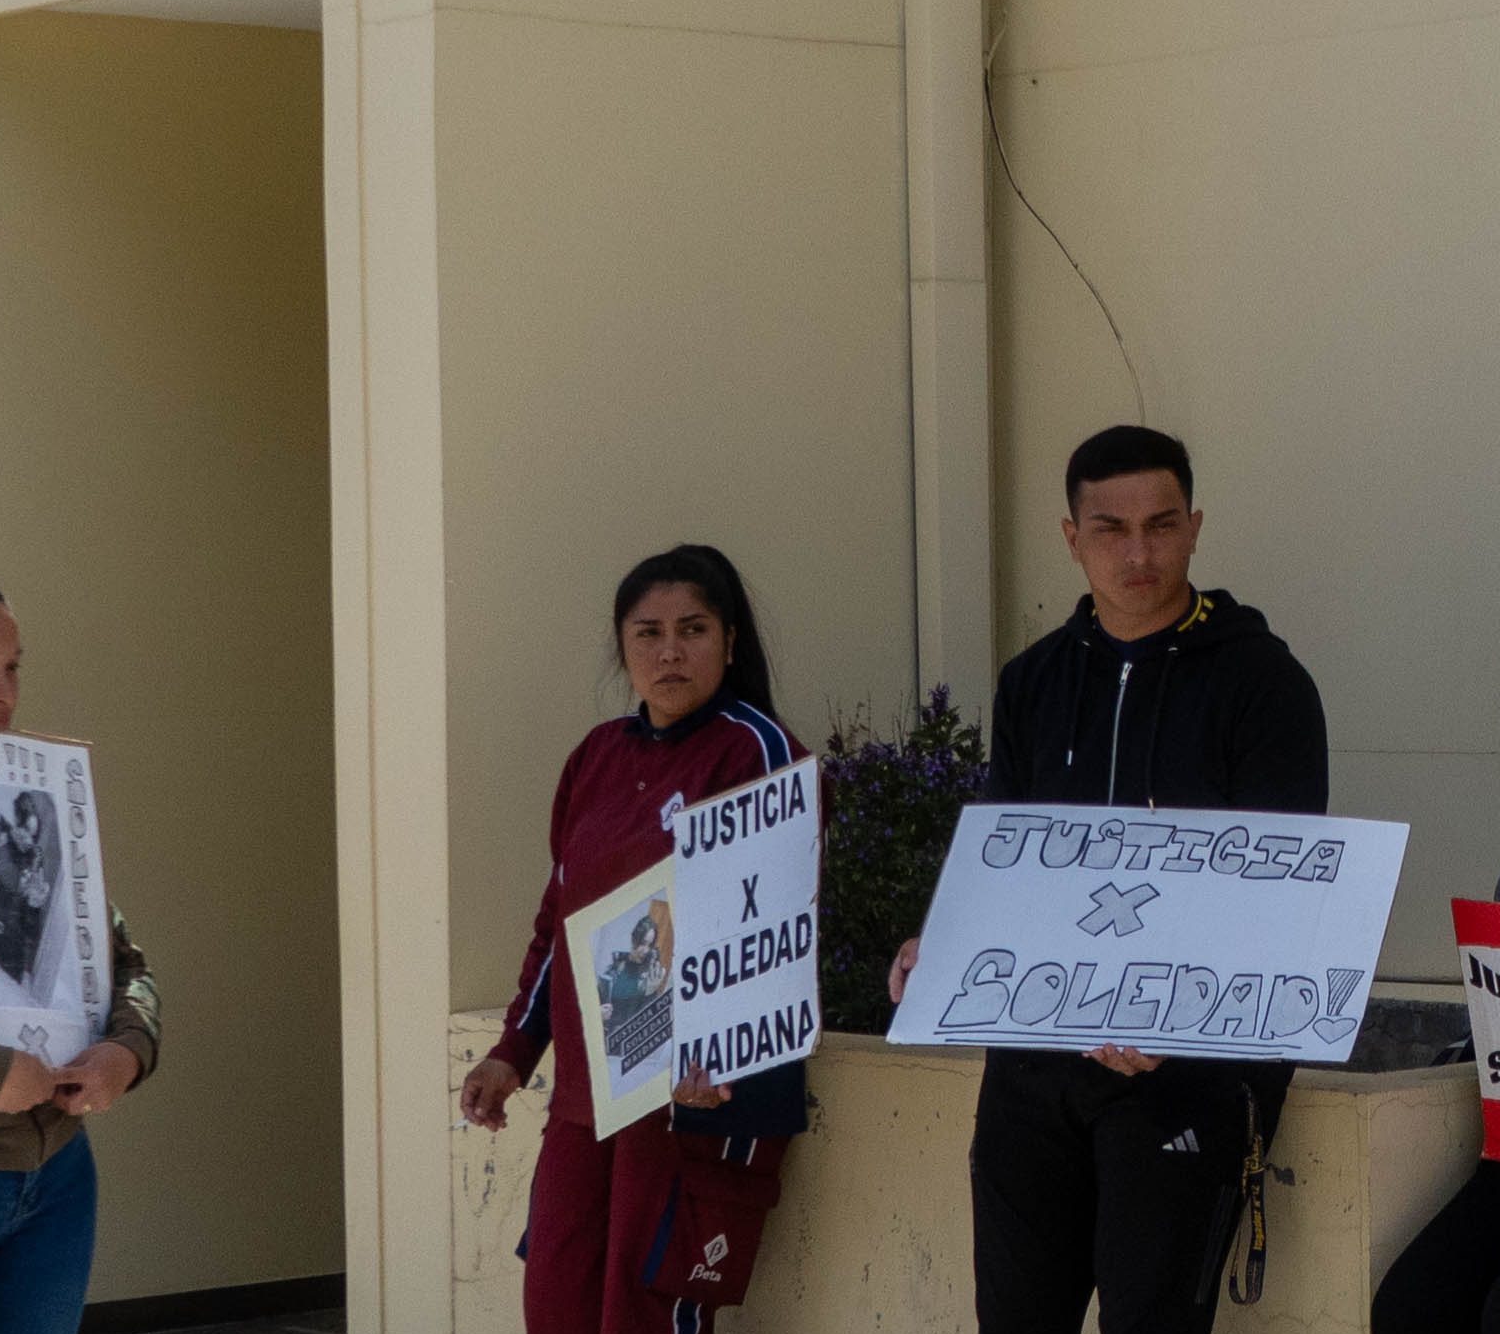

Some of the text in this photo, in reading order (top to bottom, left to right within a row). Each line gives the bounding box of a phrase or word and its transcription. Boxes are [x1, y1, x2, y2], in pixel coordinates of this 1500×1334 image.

[681, 772, 807, 859] JUSTICIA
[982, 814, 1345, 883] JUSTICIA
[741, 874, 759, 922] X
[1076, 882, 1160, 937] X
[680, 913, 812, 1002] SOLEDAD
[611, 1009, 654, 1048] JUSTICIA
[626, 1013, 669, 1051] SOLEDAD
[679, 1000, 814, 1081] MAIDANA
